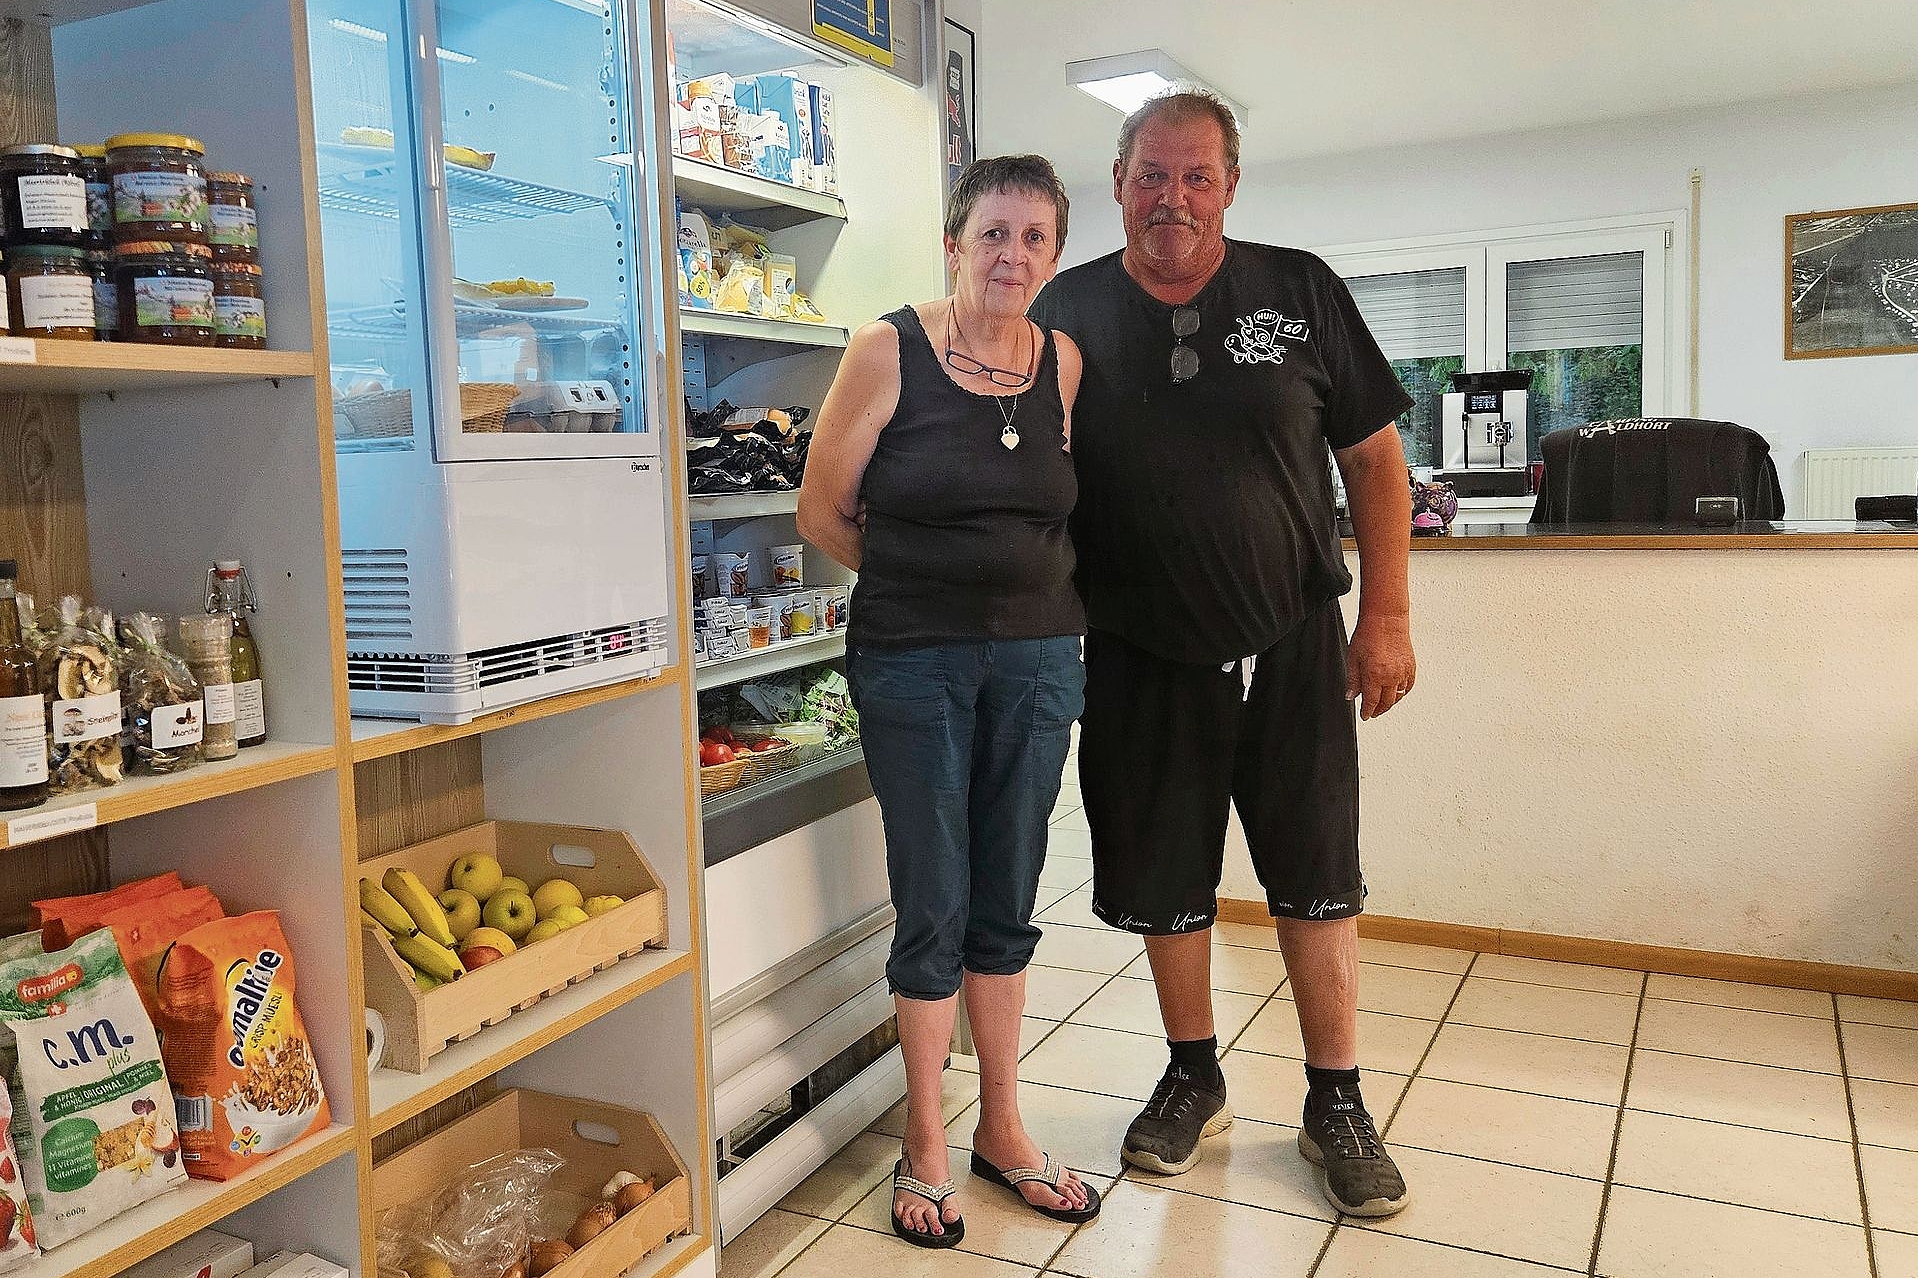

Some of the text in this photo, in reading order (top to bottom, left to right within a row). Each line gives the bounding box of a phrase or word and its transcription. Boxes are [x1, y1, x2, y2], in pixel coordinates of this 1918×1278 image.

[1283, 323, 1303, 335] 60
[1309, 898, 1349, 918] Union
[1118, 912, 1152, 930] Union
[1171, 911, 1208, 931] Union
[22, 975, 66, 997] familia
[107, 1047, 131, 1076] plus
[56, 1091, 77, 1104] APFEL
[83, 1080, 125, 1099] ORIGINAL
[60, 1097, 83, 1110] HONIG
